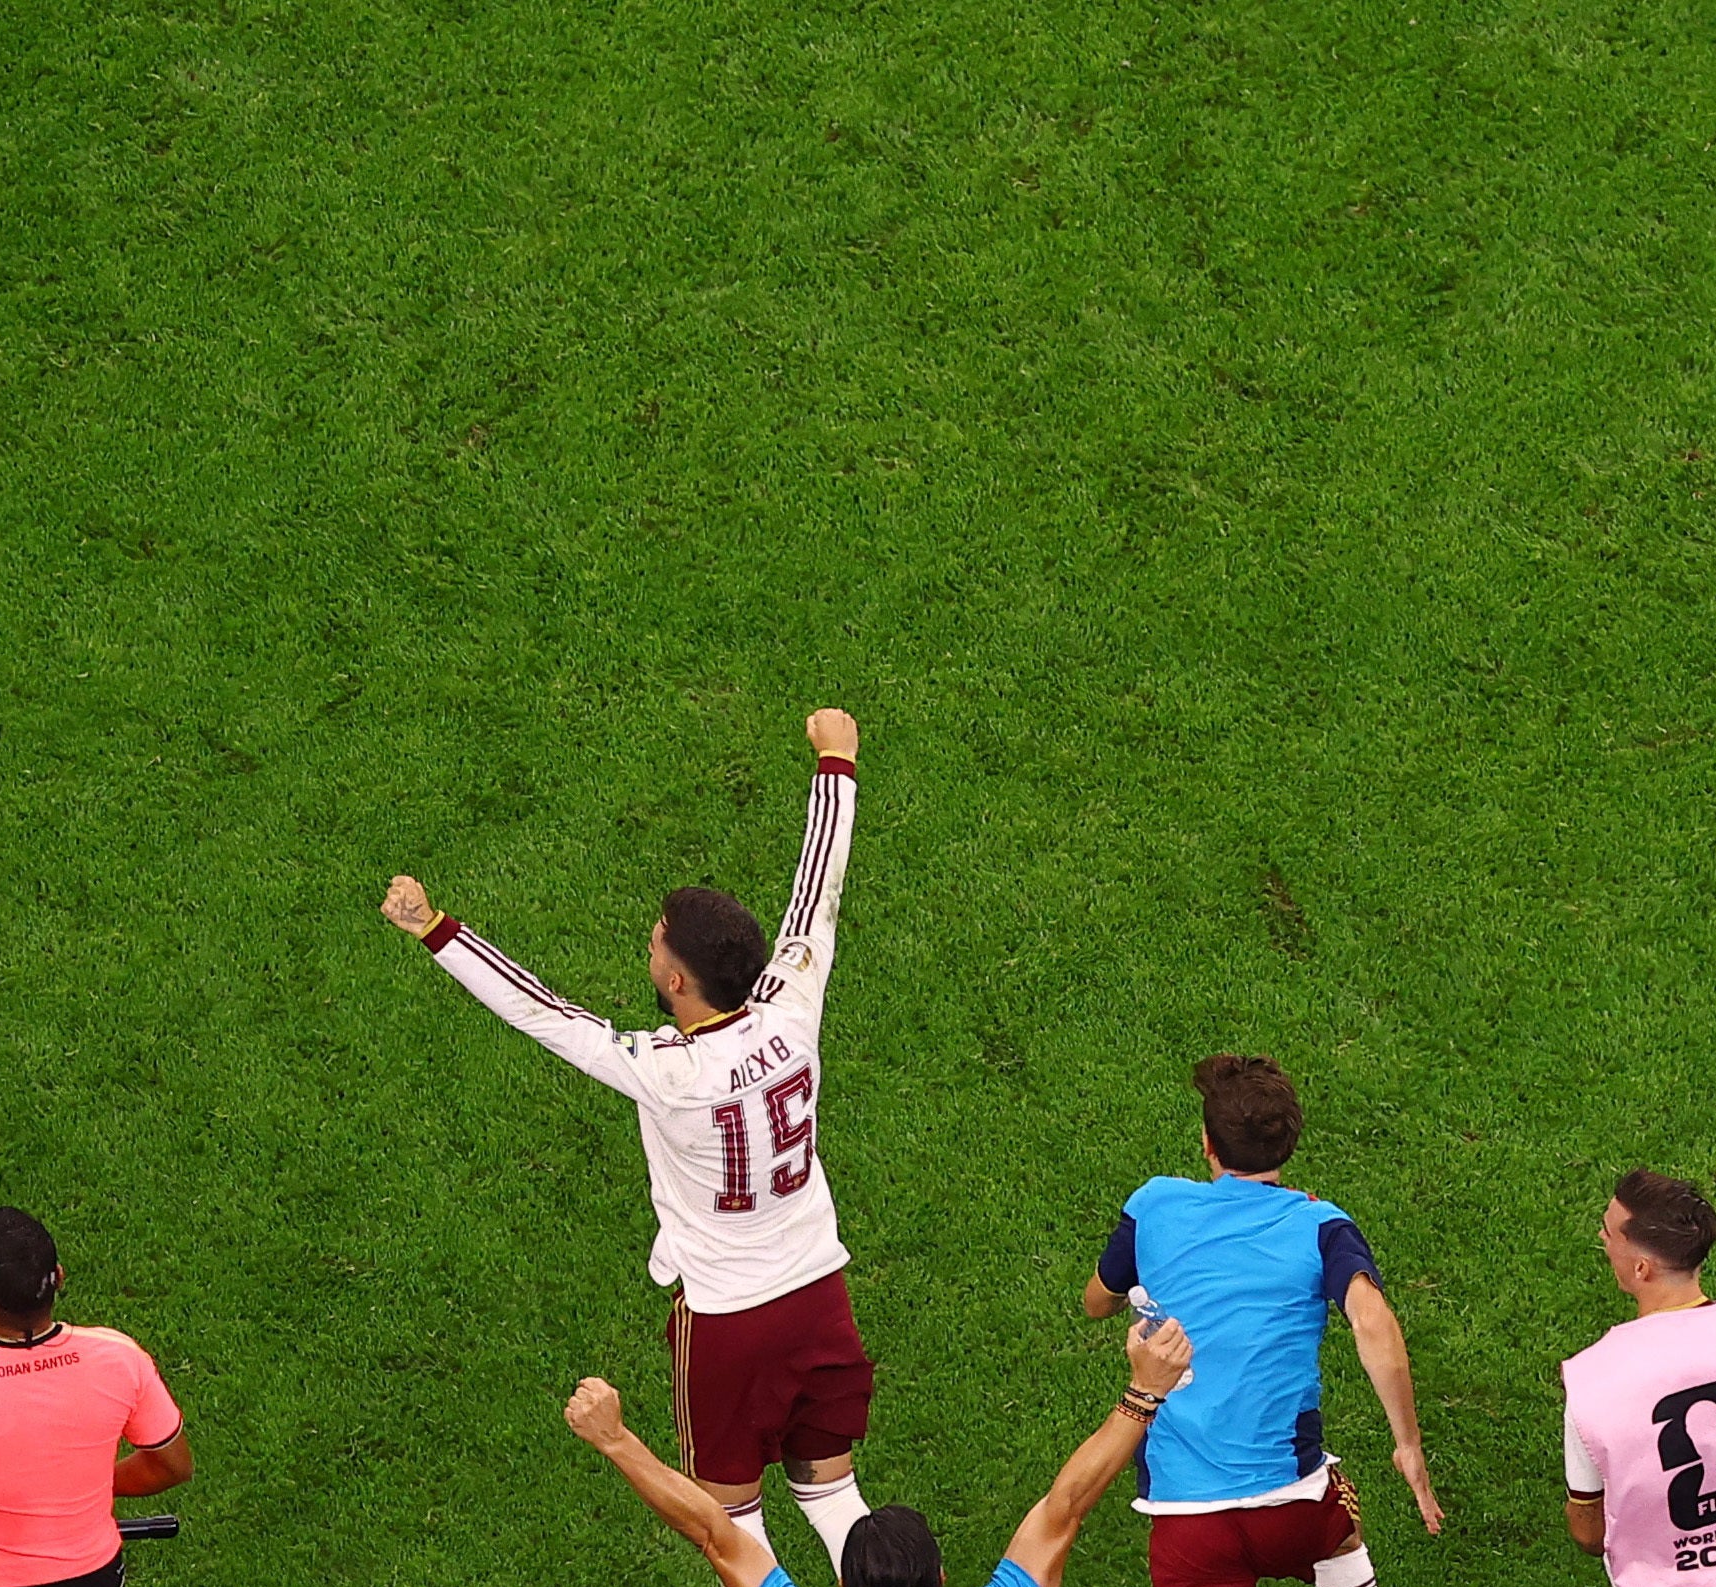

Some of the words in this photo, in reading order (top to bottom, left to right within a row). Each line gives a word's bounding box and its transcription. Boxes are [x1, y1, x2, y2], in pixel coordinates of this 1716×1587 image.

[730, 1047, 776, 1094] ALEX
[768, 1035, 794, 1063] B.
[712, 1062, 814, 1213] 15
[33, 1351, 80, 1372] SANTOS
